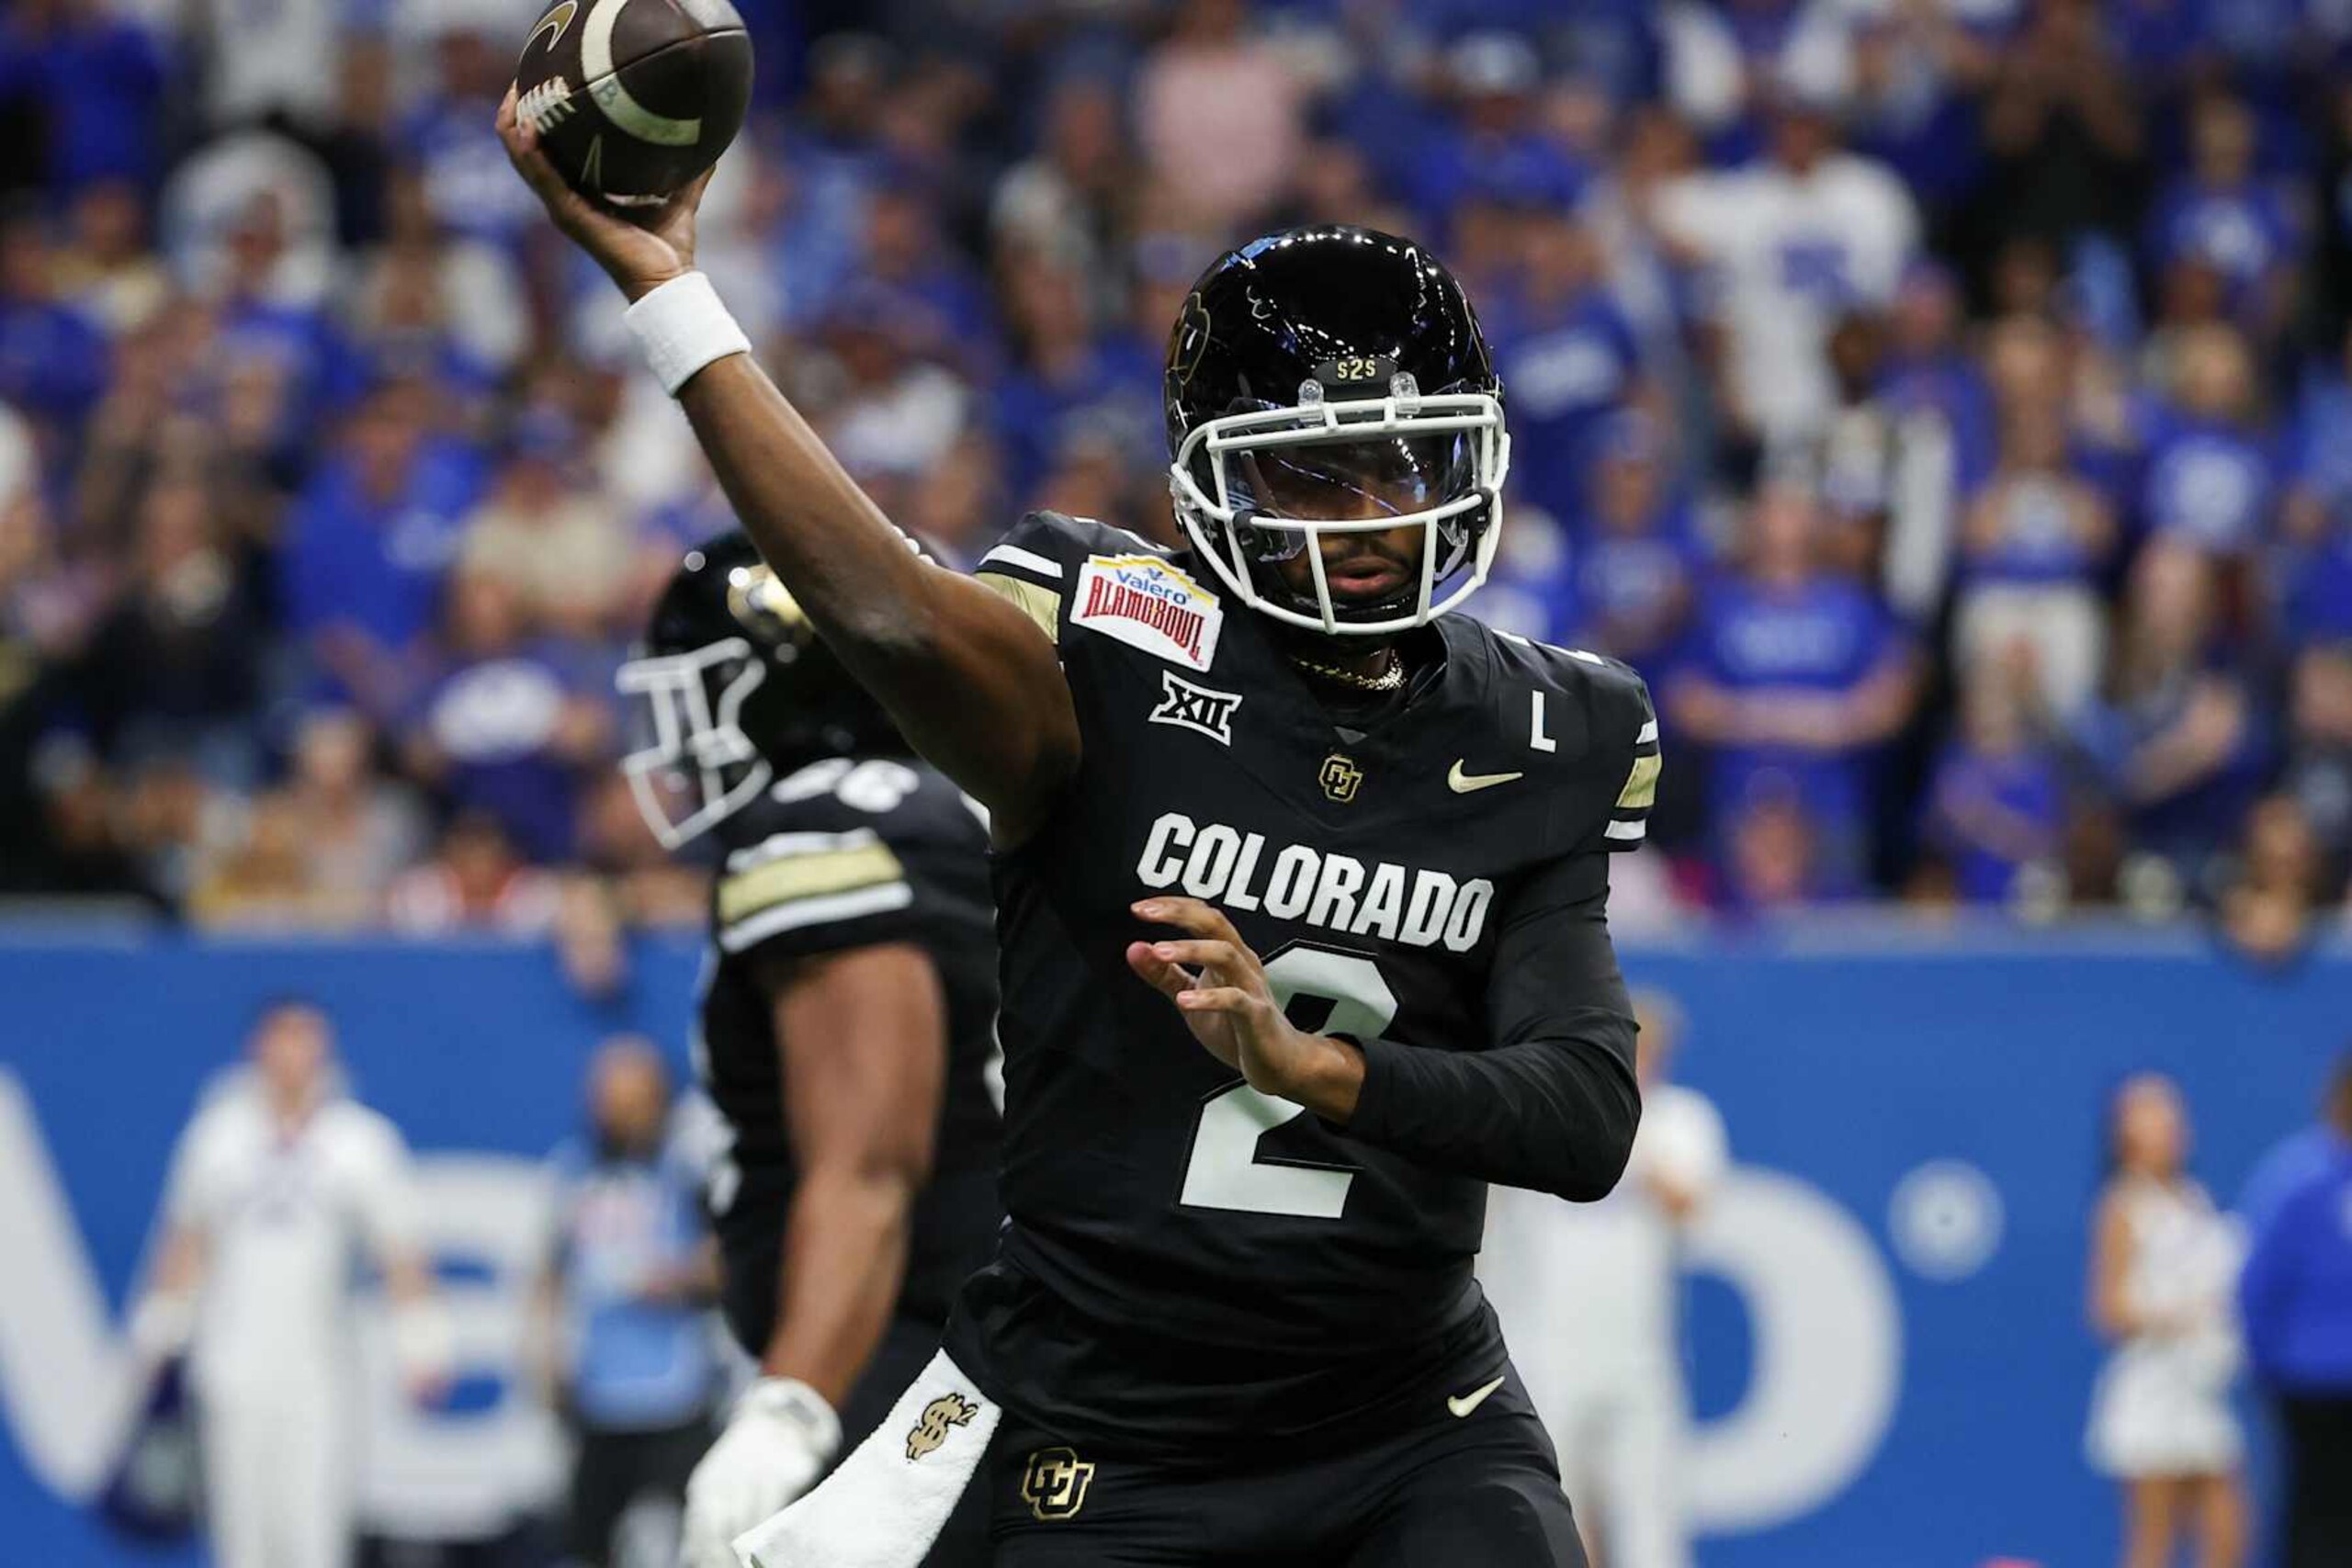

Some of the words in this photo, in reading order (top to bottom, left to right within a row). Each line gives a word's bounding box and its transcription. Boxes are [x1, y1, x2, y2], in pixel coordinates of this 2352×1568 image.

[1337, 358, 1376, 380] S2S
[1115, 569, 1188, 605] Valero
[1152, 672, 1238, 742] XII
[1531, 690, 1556, 753] L
[1136, 812, 1495, 953] COLORADO
[1180, 946, 1399, 1220] 2
